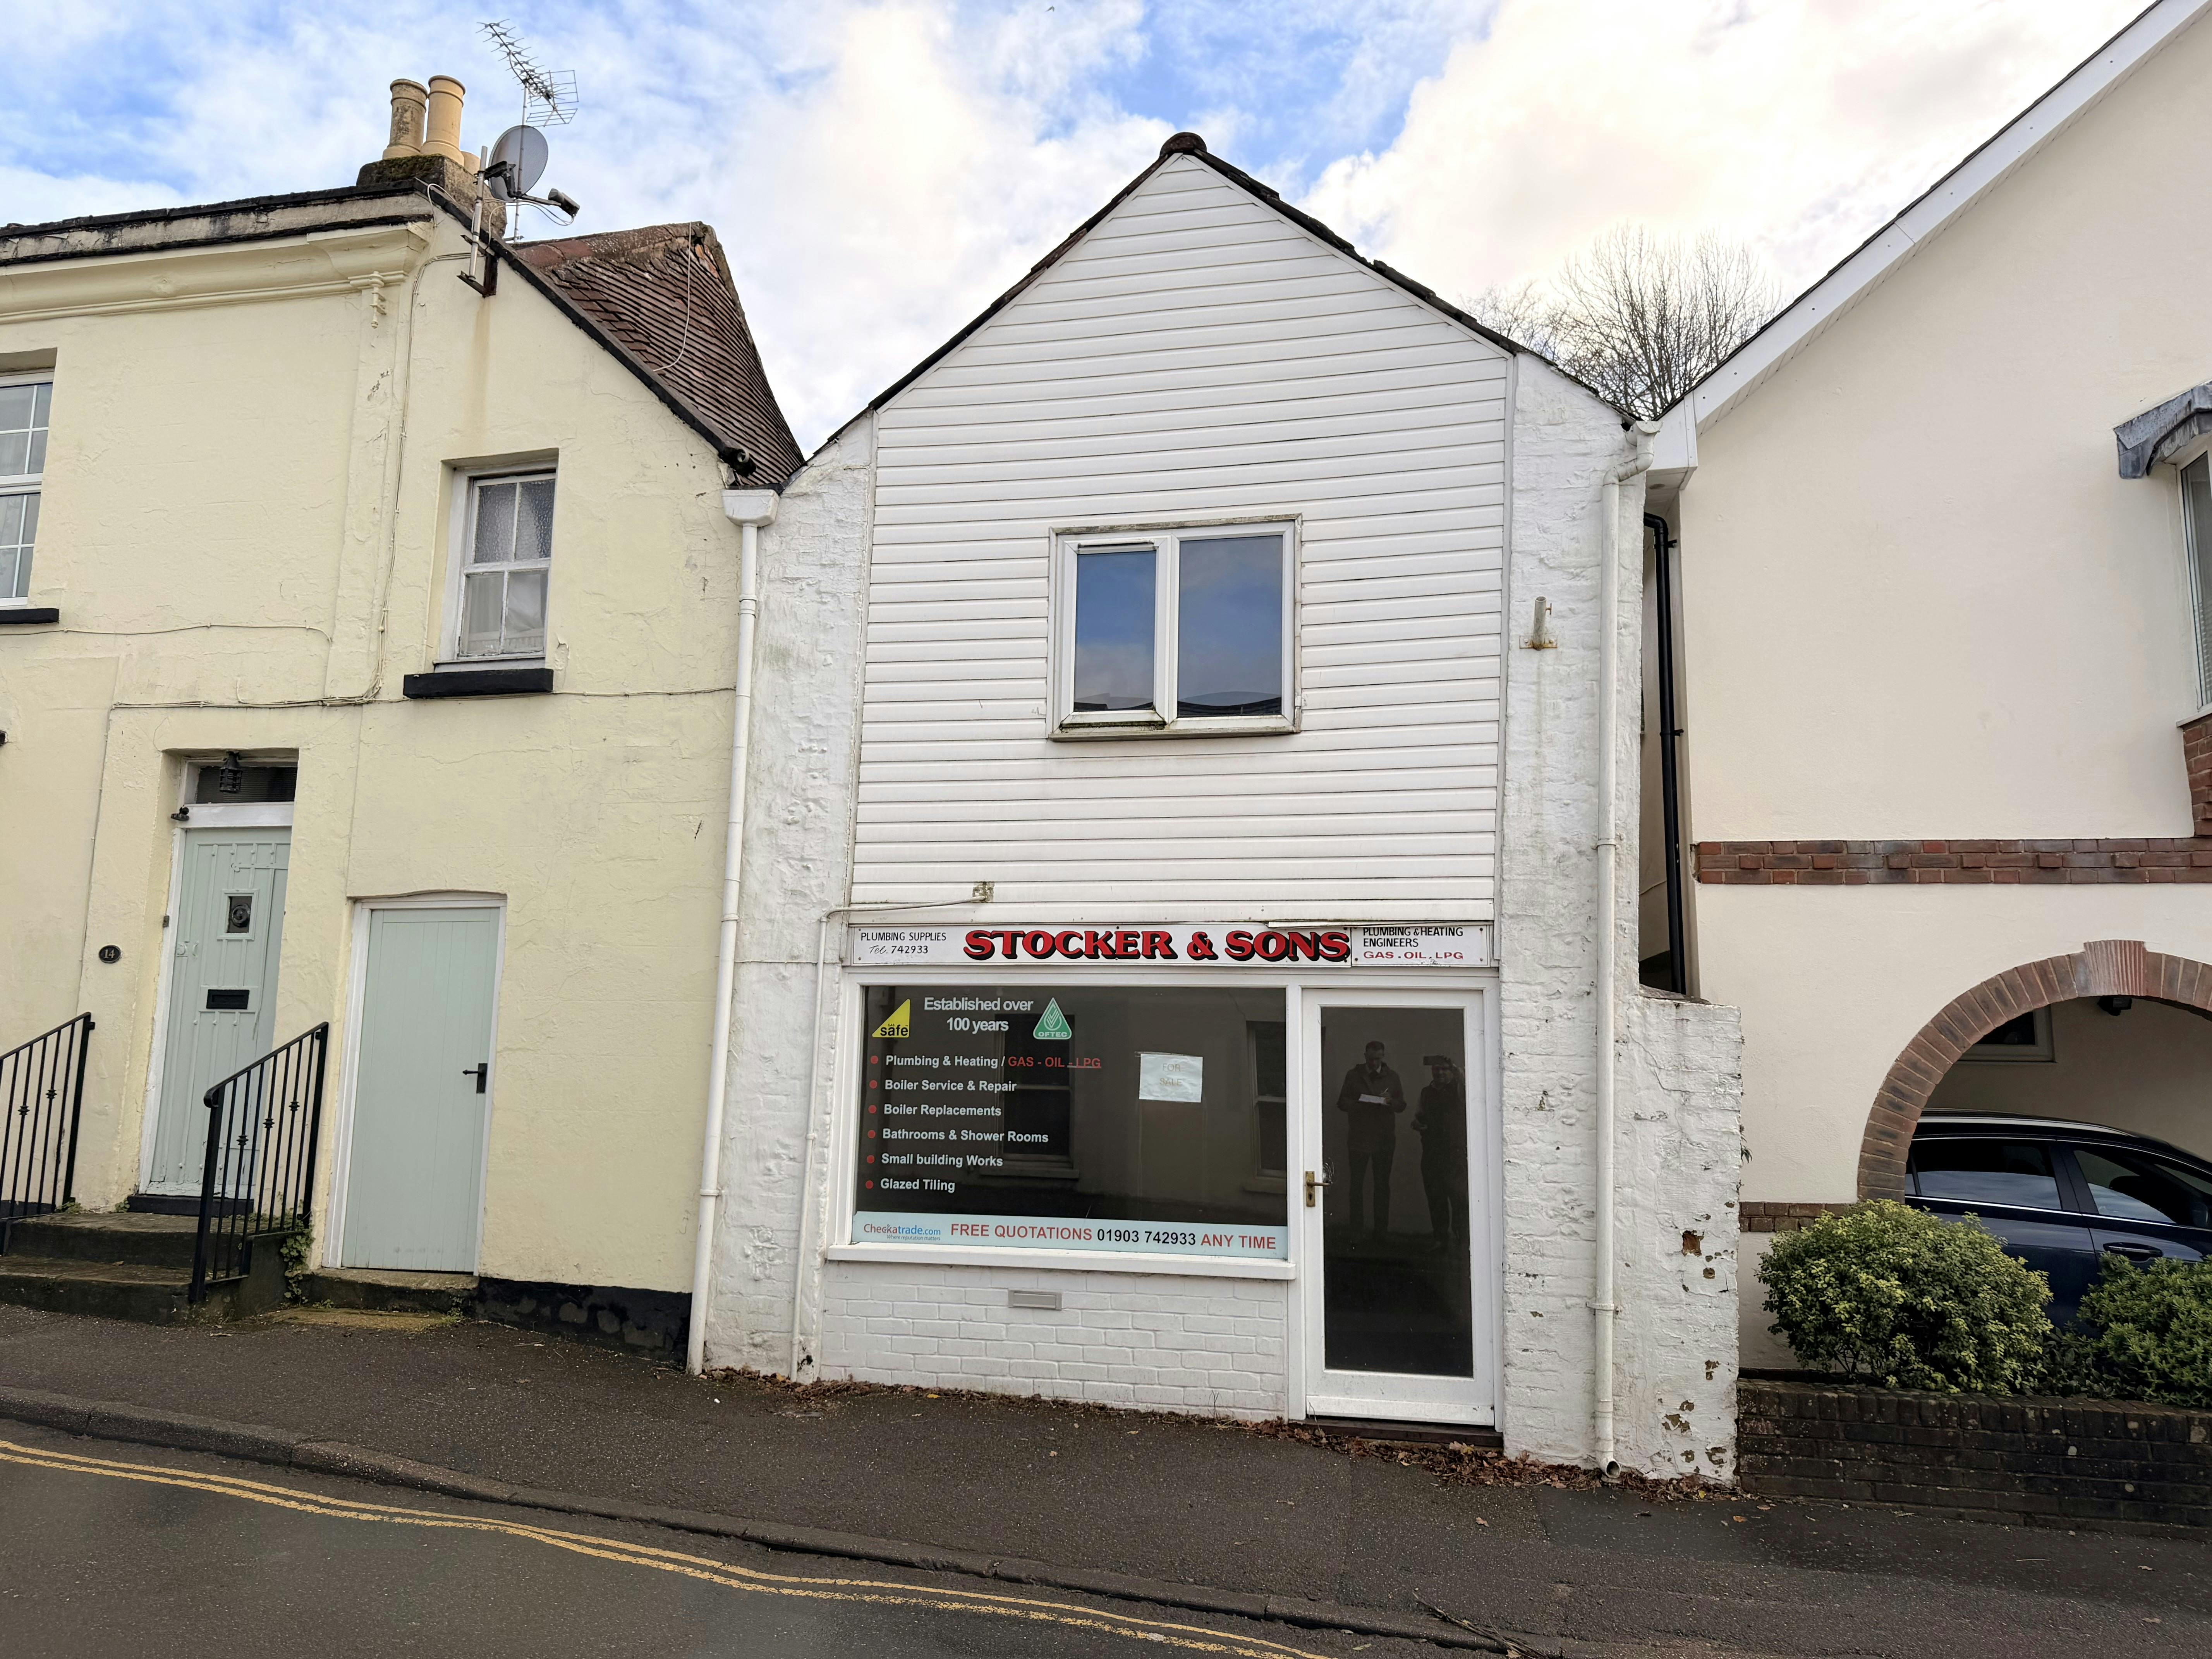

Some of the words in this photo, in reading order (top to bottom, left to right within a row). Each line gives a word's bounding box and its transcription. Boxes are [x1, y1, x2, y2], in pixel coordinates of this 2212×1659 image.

[861, 932, 905, 941] PLUMBING
[909, 932, 946, 941] SUPPLIES
[1363, 927, 1411, 936] PLUMBING
[963, 929, 1178, 960] STOCKER
[1187, 931, 1219, 960] &
[1224, 931, 1351, 962] SONS
[1363, 938, 1419, 947] ENGINEERS
[104, 949, 115, 958] 14
[869, 945, 888, 954] Tel.
[891, 945, 928, 954] 742933
[924, 997, 1000, 1011] Established
[1003, 1000, 1033, 1011] over
[880, 1024, 908, 1036] safe
[947, 1017, 969, 1031] 100
[972, 1019, 1009, 1034] years
[886, 1056, 939, 1068] Plumbing
[943, 1056, 951, 1066] &
[955, 1056, 998, 1069] Heating
[1008, 1056, 1034, 1067] GAS
[1045, 1057, 1065, 1067] OIL
[1076, 1058, 1101, 1068] LPG
[1163, 1063, 1181, 1072] FOR
[885, 1080, 919, 1091] Boiler
[922, 1080, 963, 1091] Service
[967, 1081, 975, 1091] &
[979, 1081, 1017, 1093] Repair
[1159, 1078, 1182, 1087] SALE
[884, 1104, 917, 1115] Boiler
[921, 1105, 1001, 1117] Replacements
[883, 1129, 945, 1140] Bathrooms
[949, 1130, 957, 1140] &
[961, 1130, 1004, 1142] Shower
[1008, 1131, 1049, 1143] Rooms
[881, 1153, 913, 1164] Small
[917, 1154, 963, 1168] building
[967, 1155, 1003, 1166] Works
[880, 1178, 919, 1190] Glazed
[923, 1179, 955, 1193] Tiling
[864, 1223, 941, 1235] Checkatrade.com
[951, 1223, 989, 1237] FREE
[995, 1224, 1092, 1241] QUOTATIONS
[1097, 1229, 1139, 1242] 01903
[1144, 1231, 1196, 1245] 742933
[1200, 1233, 1234, 1247] ANY
[1238, 1235, 1276, 1250] TIME
